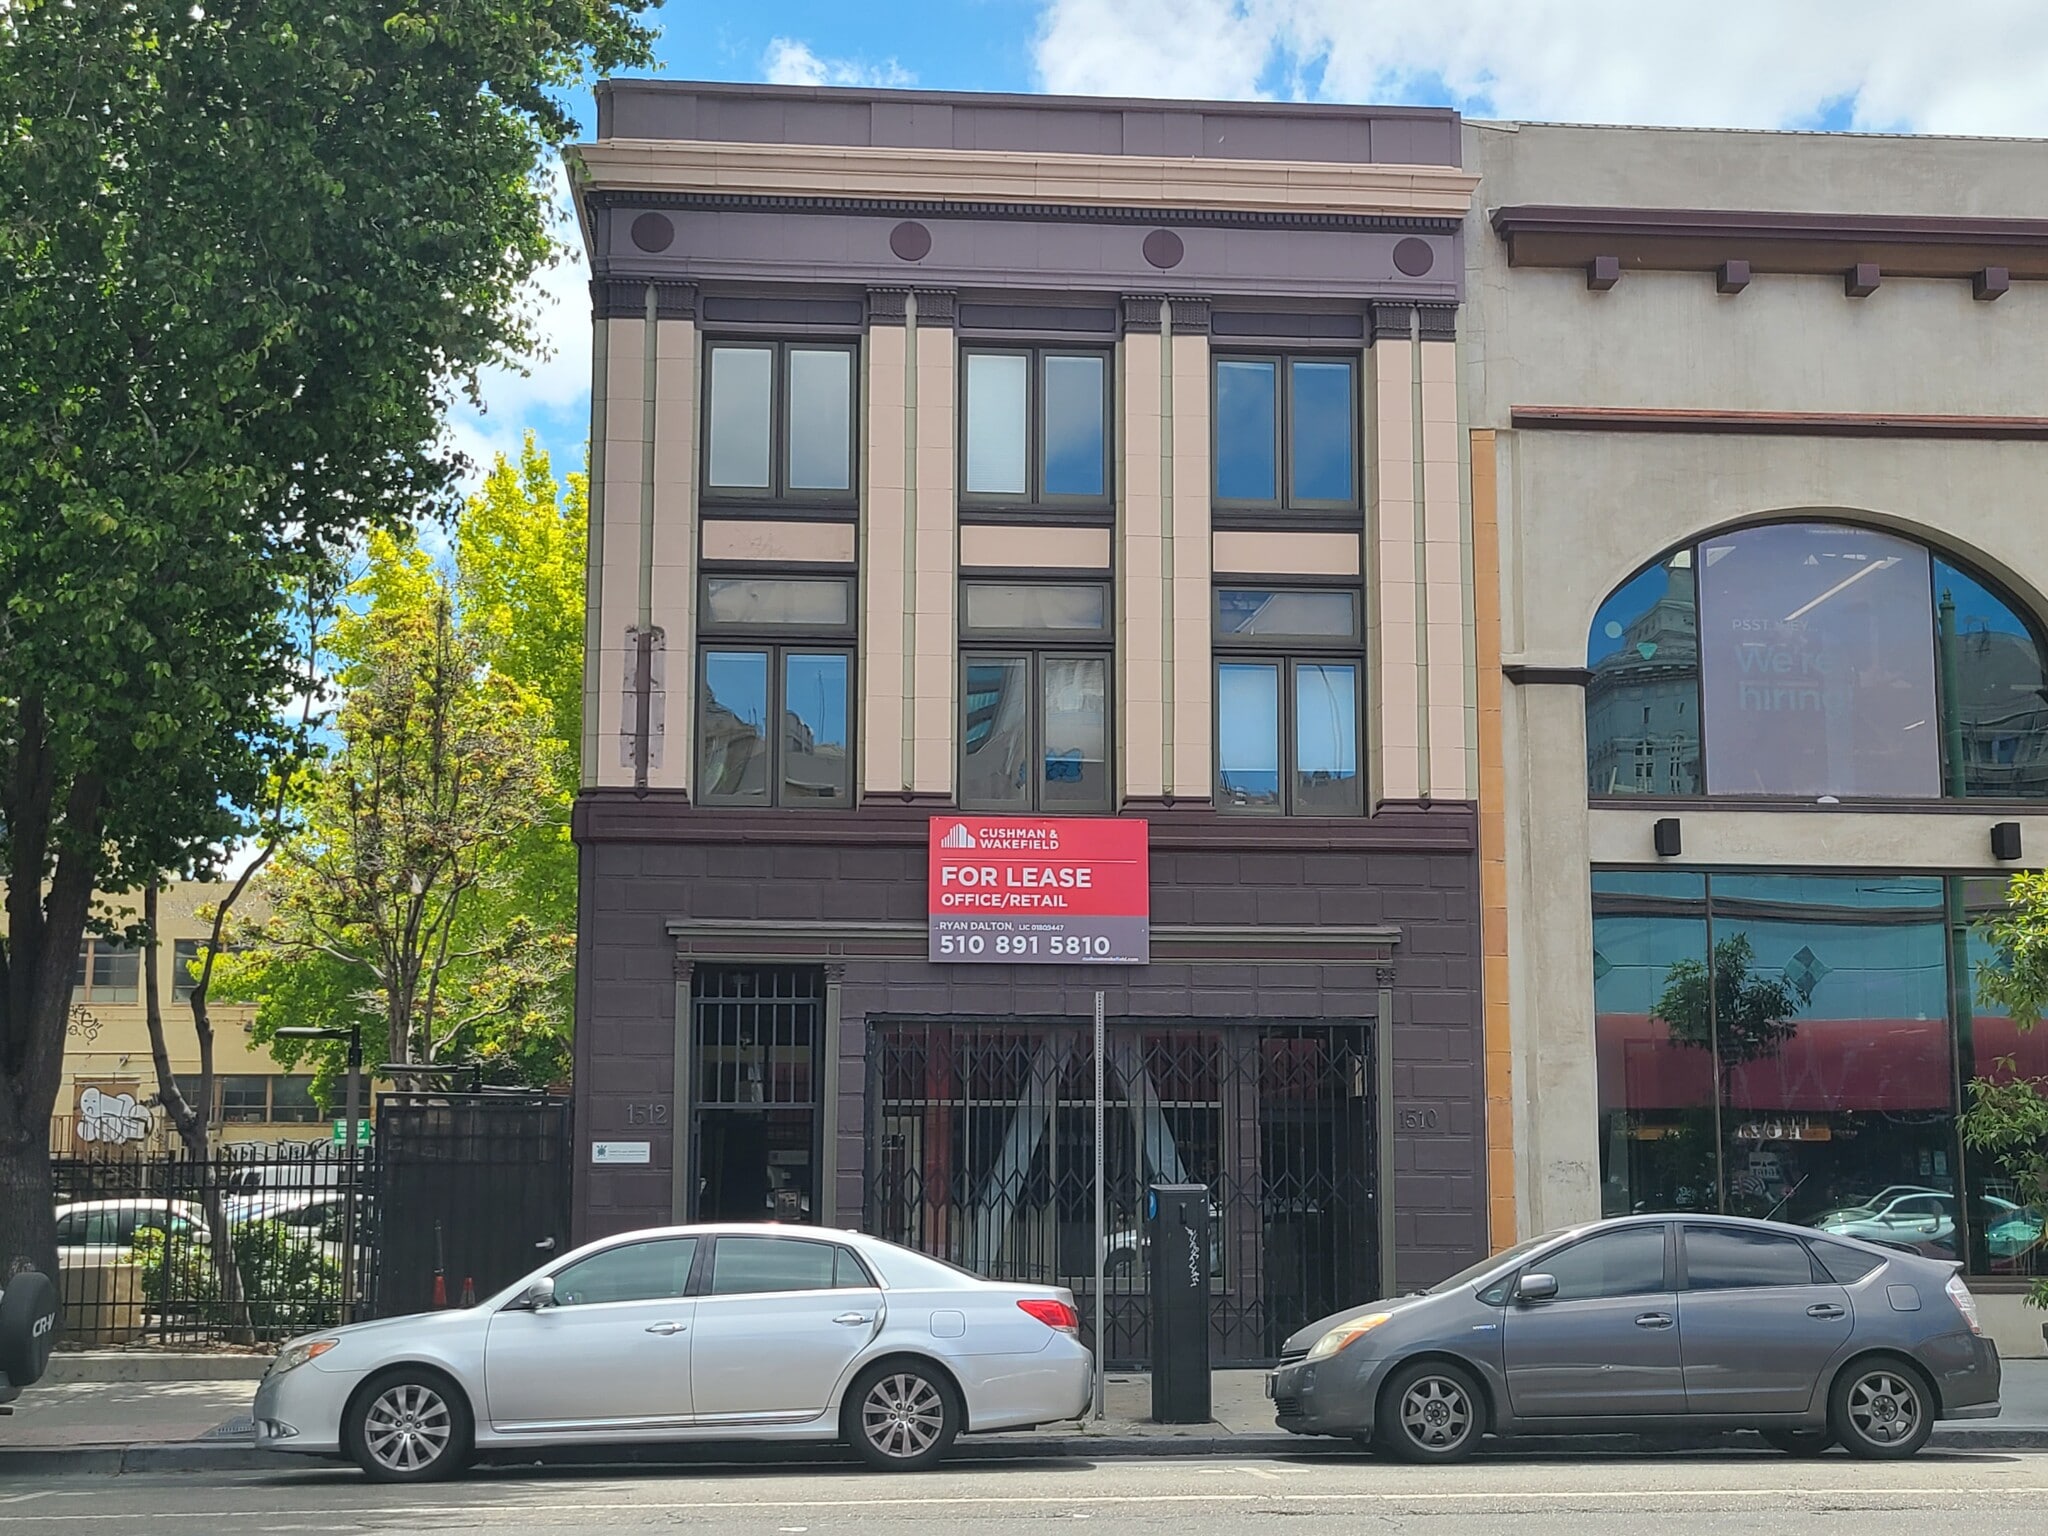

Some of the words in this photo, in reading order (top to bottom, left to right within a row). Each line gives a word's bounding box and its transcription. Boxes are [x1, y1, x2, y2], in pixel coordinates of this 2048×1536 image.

[979, 828, 1046, 839] CUSHMAN
[1049, 829, 1058, 839] &
[979, 839, 1059, 850] WAKEFIELD
[941, 866, 998, 887] FOR
[1006, 867, 1092, 888] LEASE
[941, 893, 1068, 908] OFFICE/RETAIL
[940, 922, 968, 931] RYAN
[970, 922, 1014, 932] DALTON,
[940, 935, 985, 954] 510
[996, 936, 1038, 954] 891
[1049, 936, 1111, 955] 5810
[626, 1104, 668, 1125] 1512
[1399, 1108, 1438, 1129] 1510
